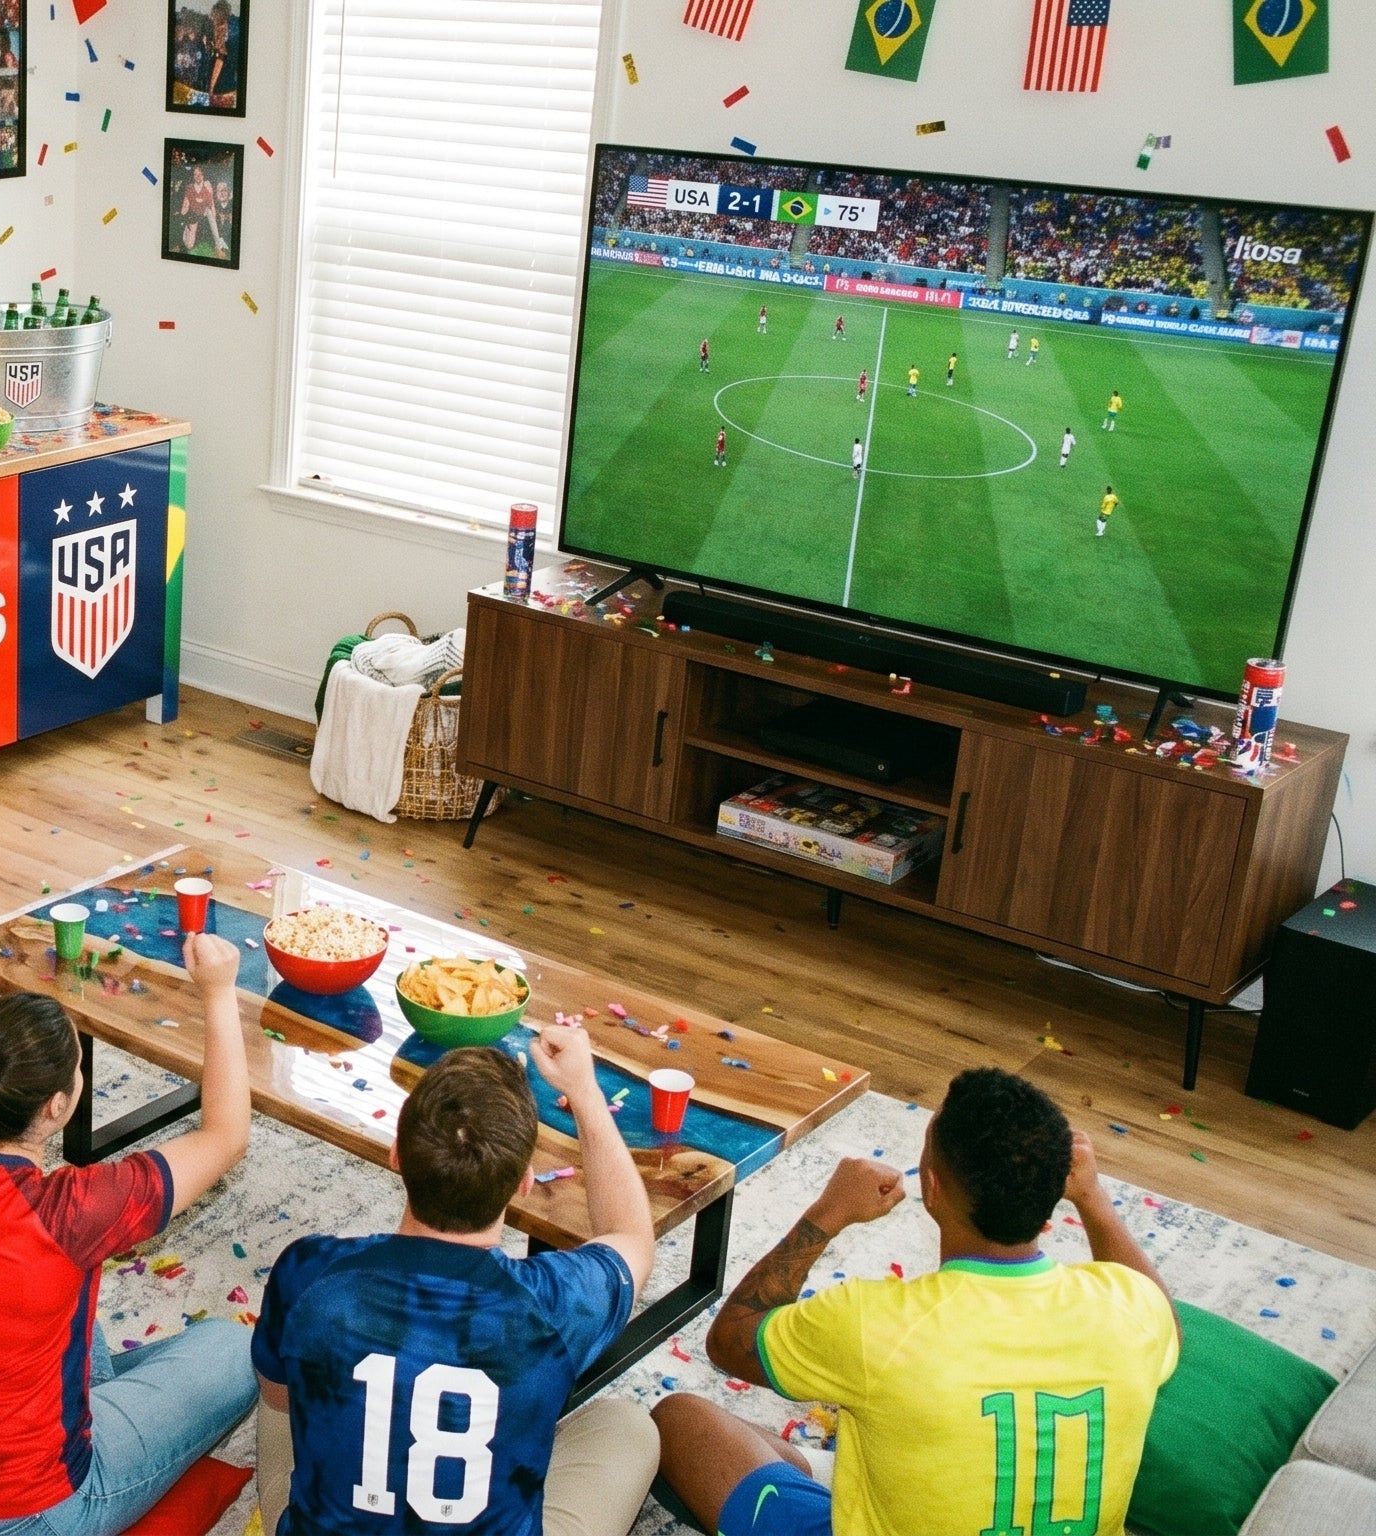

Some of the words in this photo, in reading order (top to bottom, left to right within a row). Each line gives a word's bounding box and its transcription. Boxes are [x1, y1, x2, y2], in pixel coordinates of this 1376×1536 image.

[675, 188, 709, 207] USA
[728, 192, 760, 213] 2-1
[838, 204, 865, 222] 75'
[9, 365, 39, 382] USA
[58, 529, 130, 593] USA
[352, 1353, 500, 1524] 18
[980, 1387, 1104, 1536] 10
